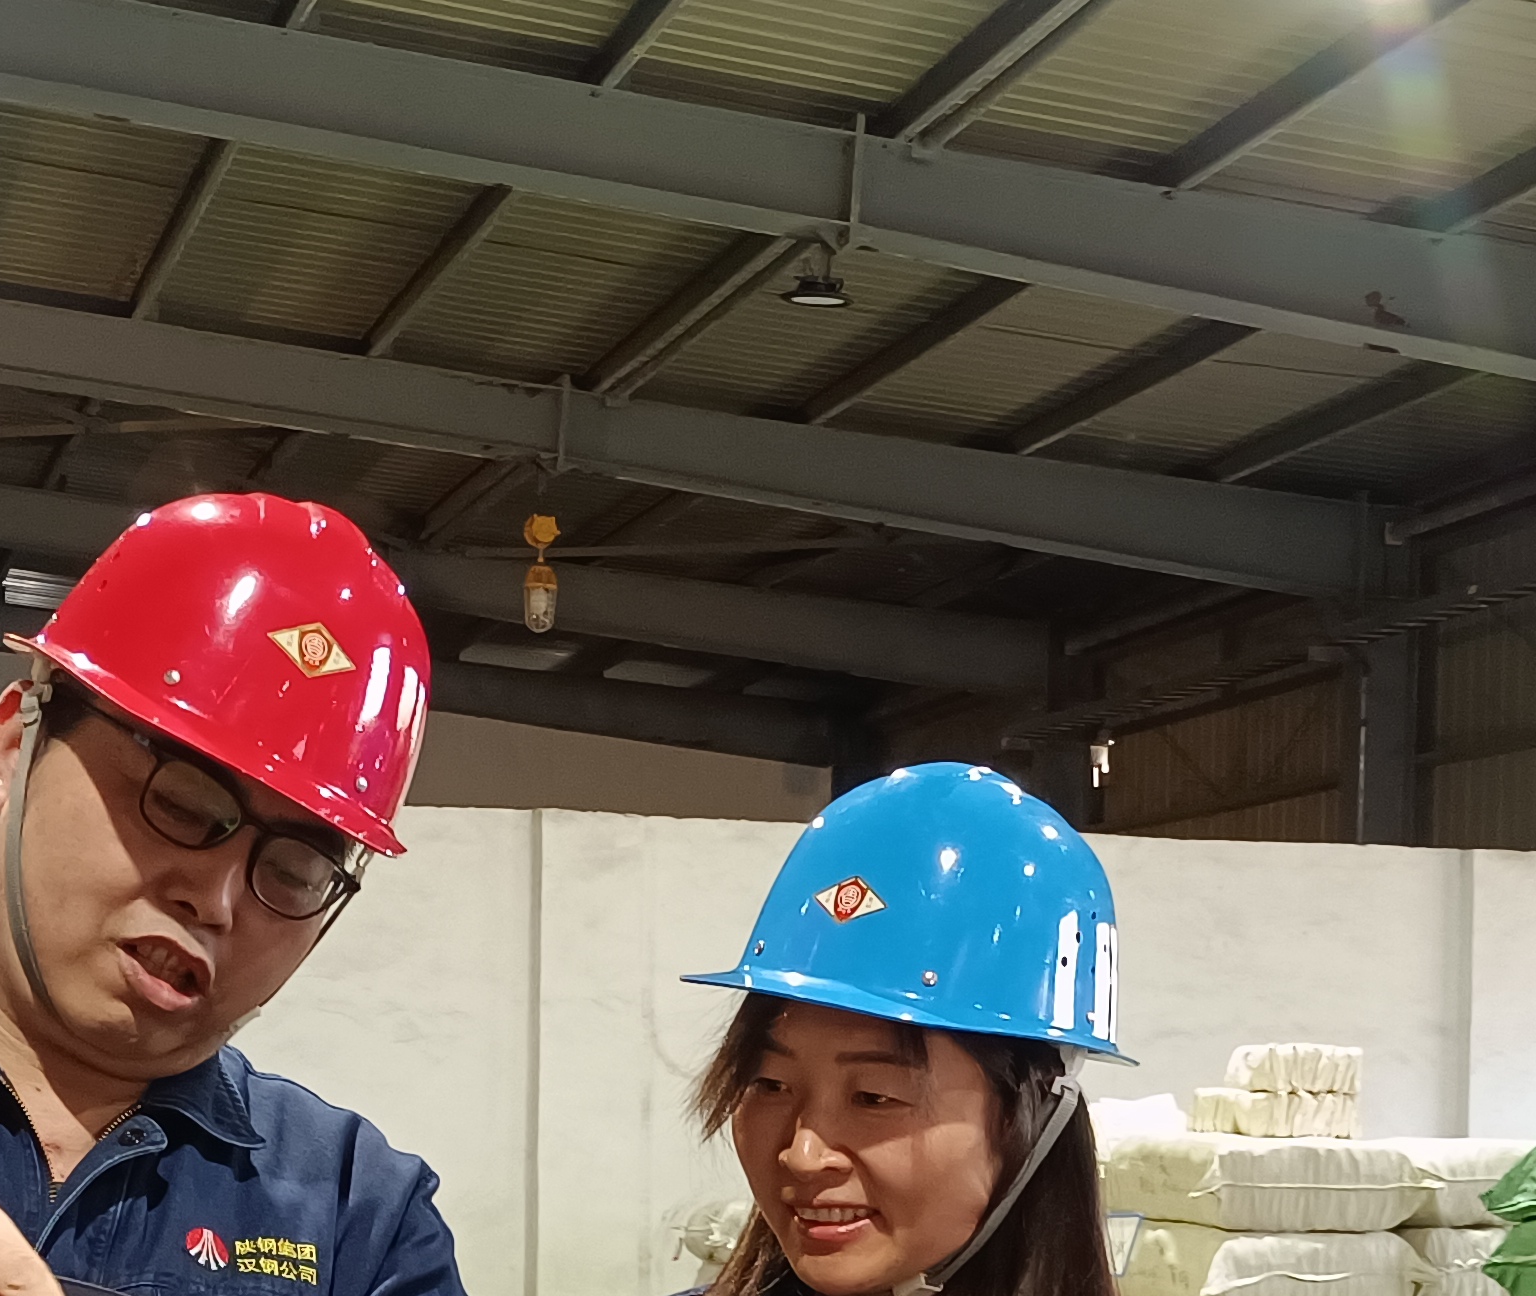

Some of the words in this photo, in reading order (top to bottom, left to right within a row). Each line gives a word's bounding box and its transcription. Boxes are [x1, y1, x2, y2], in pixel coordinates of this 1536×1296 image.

[235, 1236, 317, 1264] 陕钢集团
[236, 1257, 317, 1286] 汉钢公司
